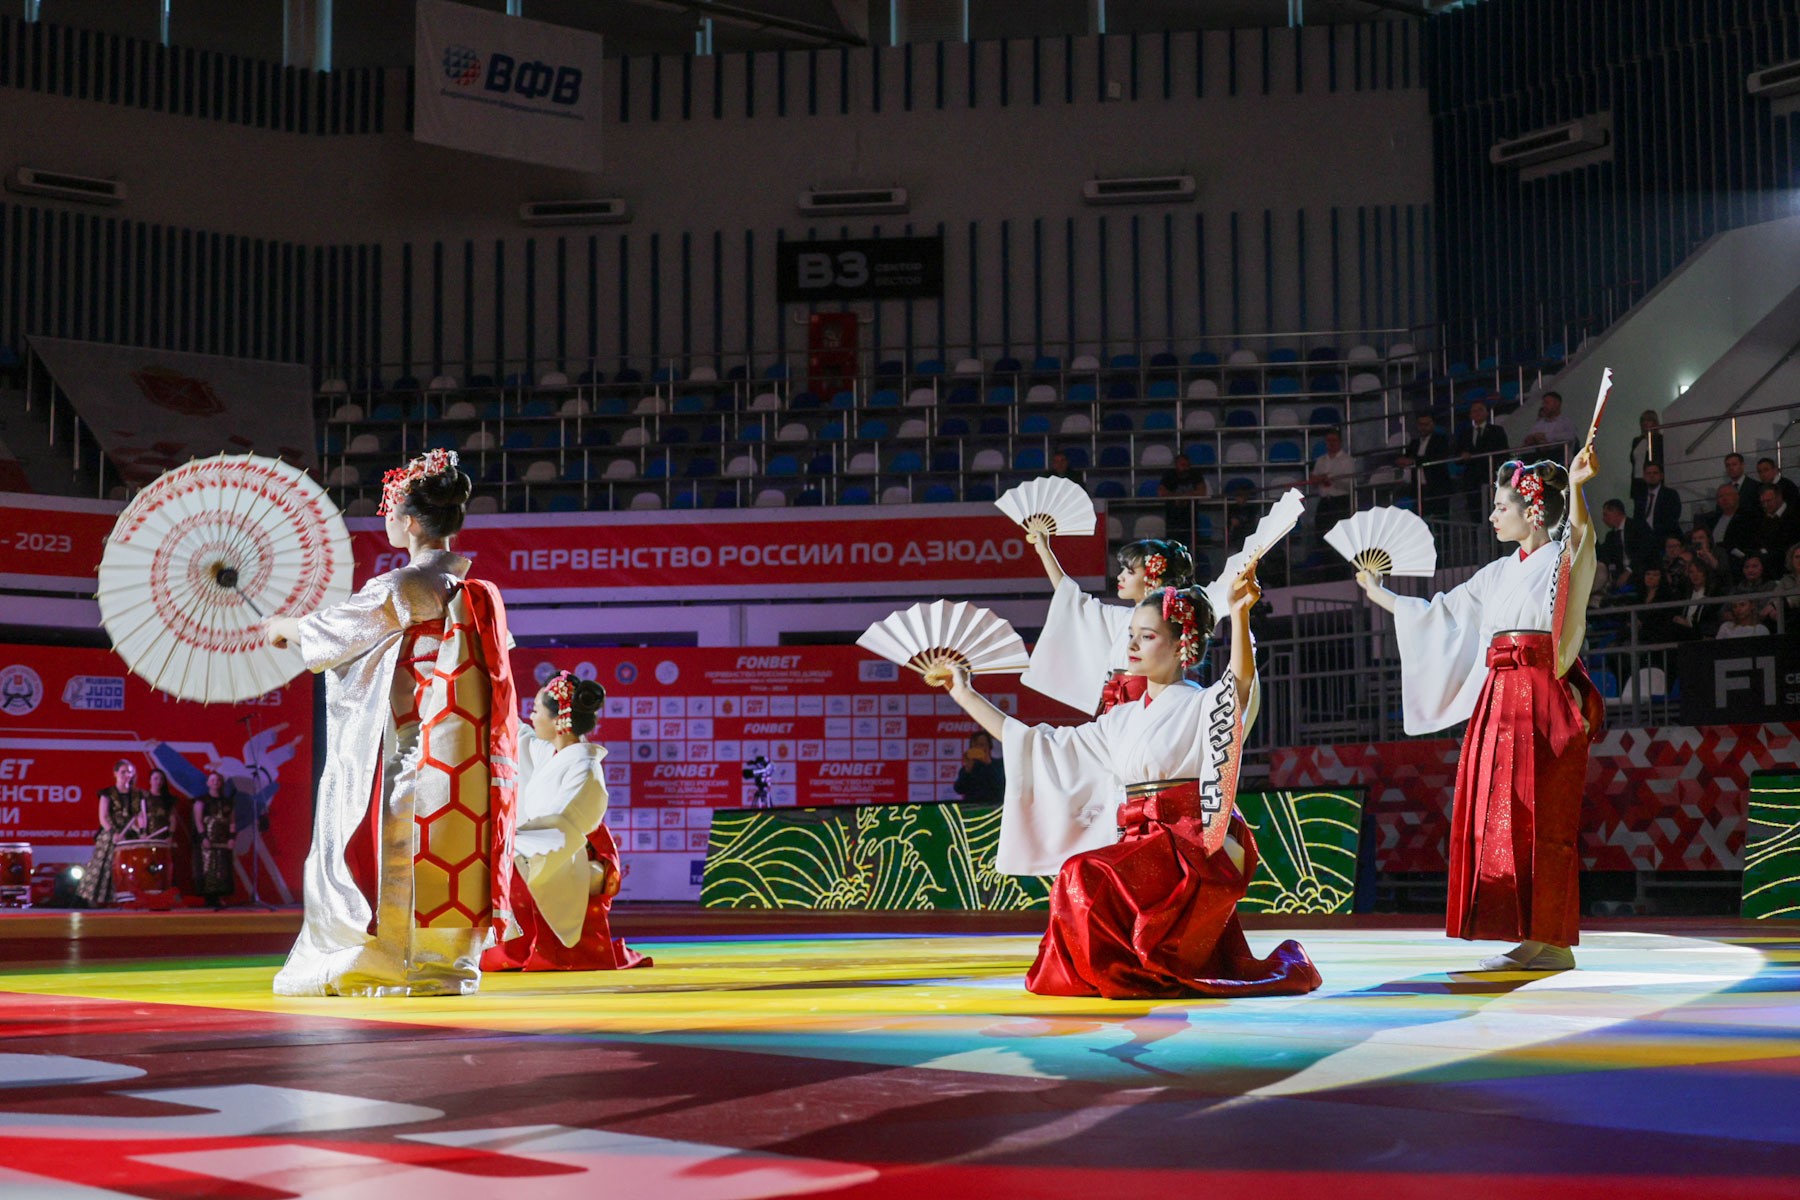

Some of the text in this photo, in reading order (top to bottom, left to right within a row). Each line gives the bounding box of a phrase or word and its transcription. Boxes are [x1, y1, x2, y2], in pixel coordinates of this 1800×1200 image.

[484, 53, 582, 105] ВФВ
[797, 251, 869, 288] B3
[15, 532, 72, 553] 2023
[510, 538, 1024, 571] ПЕРВЕНСТВО РОССИИ ПО ДЗЮДО
[736, 655, 802, 669] FONBET
[1714, 655, 1777, 709] F1
[85, 686, 122, 696] JUDO
[85, 698, 122, 709] TOUR
[743, 723, 795, 734] FONBET
[653, 764, 719, 778] FONBET
[818, 762, 885, 776] FONBET
[0, 785, 81, 803] НСТВО
